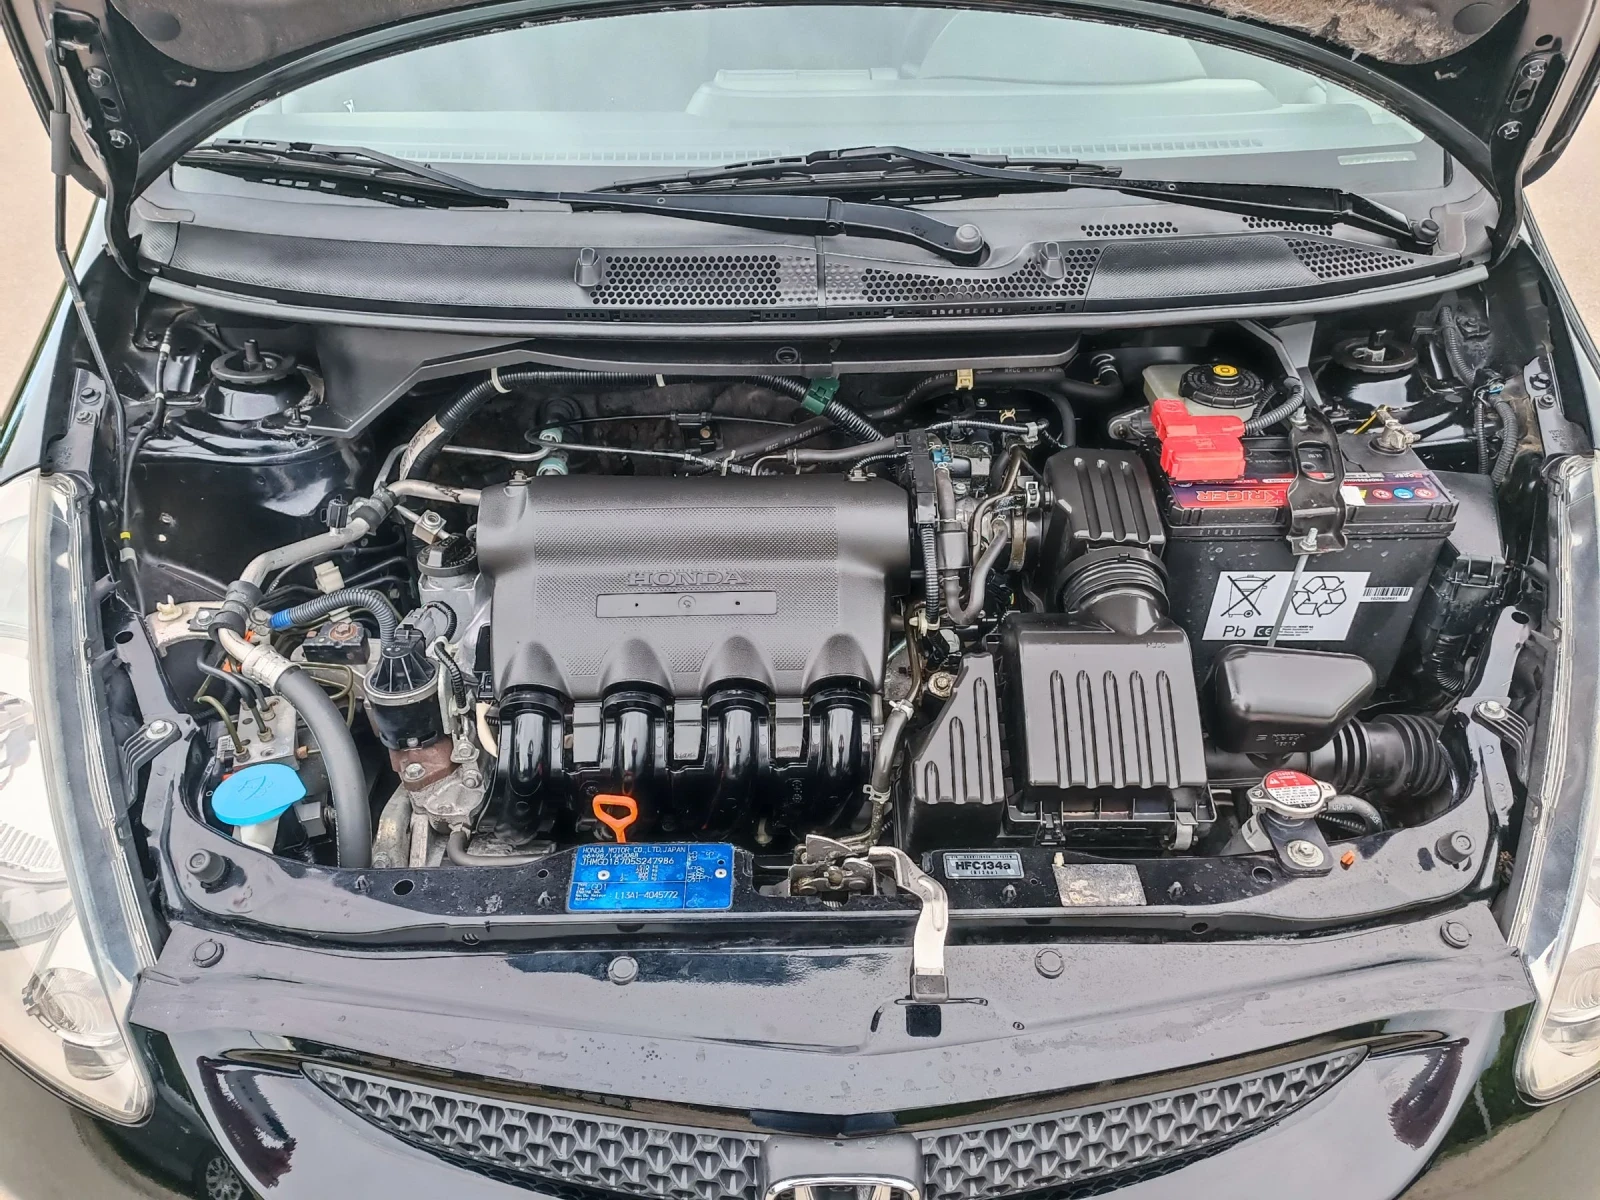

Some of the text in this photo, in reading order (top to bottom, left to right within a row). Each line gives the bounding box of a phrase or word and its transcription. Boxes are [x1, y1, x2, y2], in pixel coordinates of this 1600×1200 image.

[1196, 489, 1287, 505] KRIGER
[627, 571, 747, 587] HONDA
[1222, 625, 1247, 638] Pb
[582, 846, 604, 854] HONDA
[955, 860, 1011, 870] HFC134a
